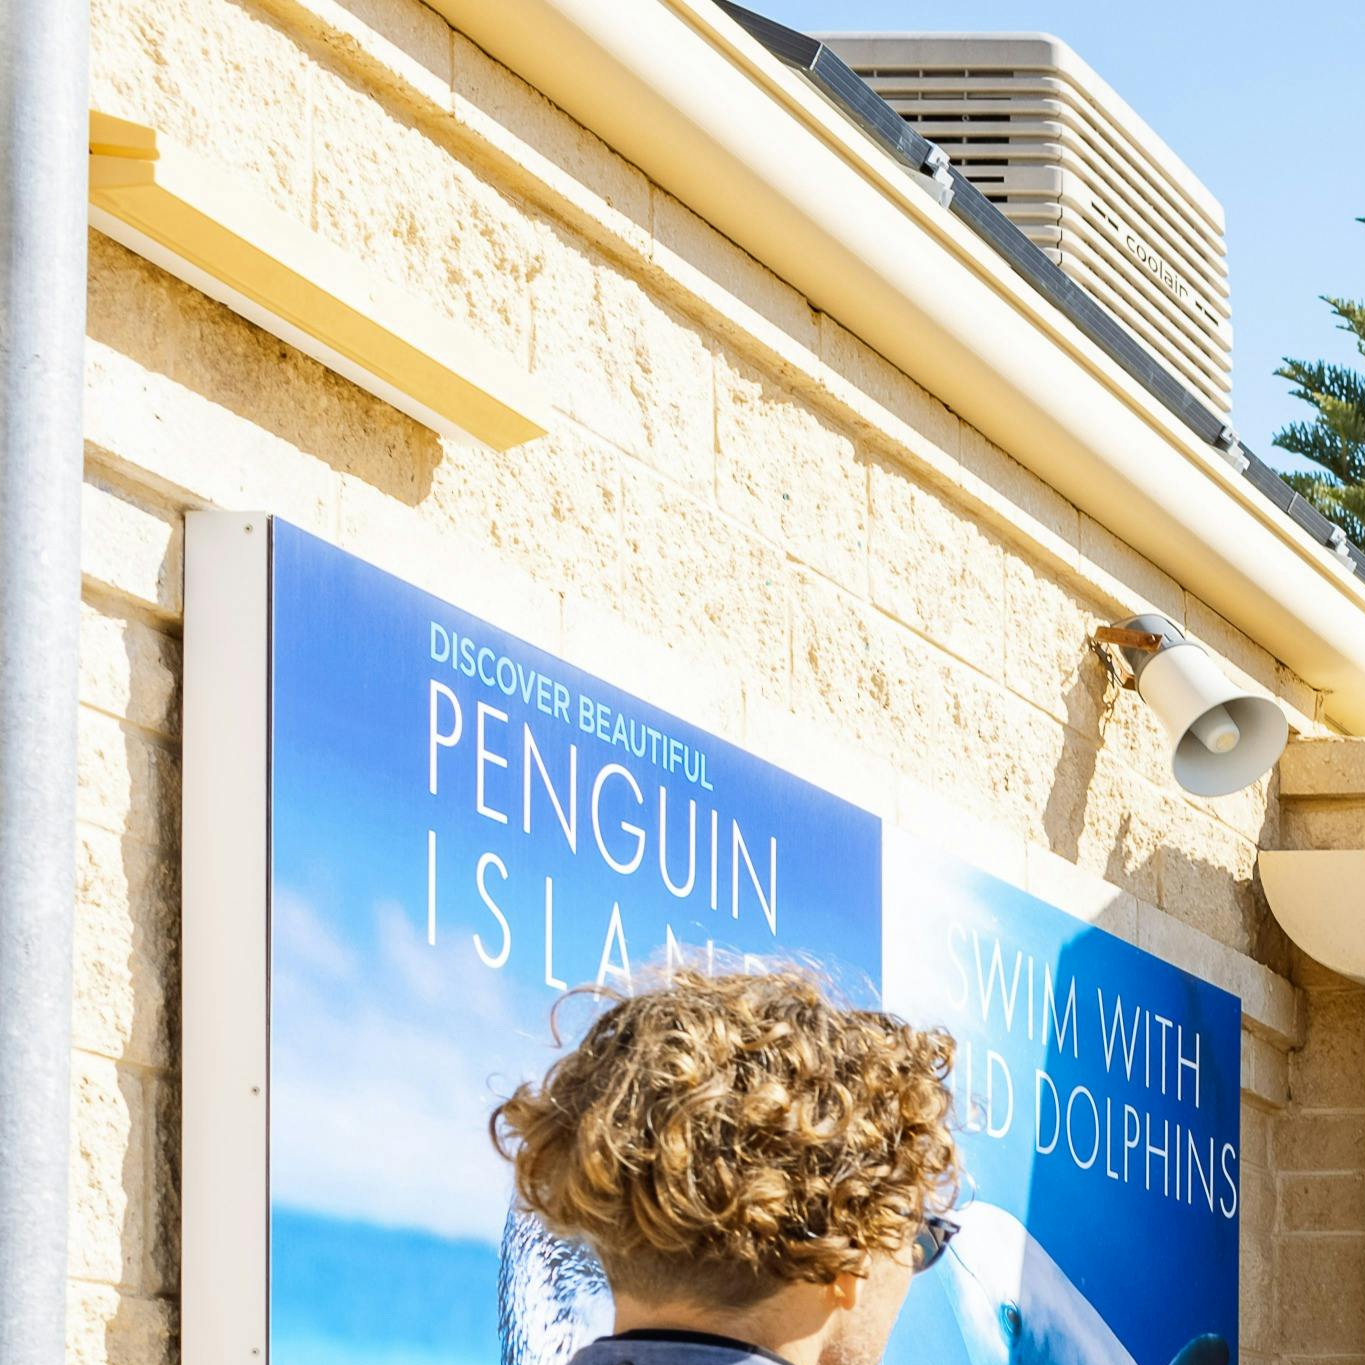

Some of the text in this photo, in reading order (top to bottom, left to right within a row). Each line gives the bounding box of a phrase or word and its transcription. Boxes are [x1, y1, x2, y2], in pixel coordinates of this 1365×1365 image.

[1126, 235, 1189, 298] coolair
[430, 620, 714, 792] DISCOVER BEAUTIFUL
[429, 678, 777, 937] PENGUIN
[428, 830, 771, 1001] ISLAN
[949, 921, 1200, 1109] SWIM WITH
[950, 1039, 1239, 1219] ILD DOLPHINS
